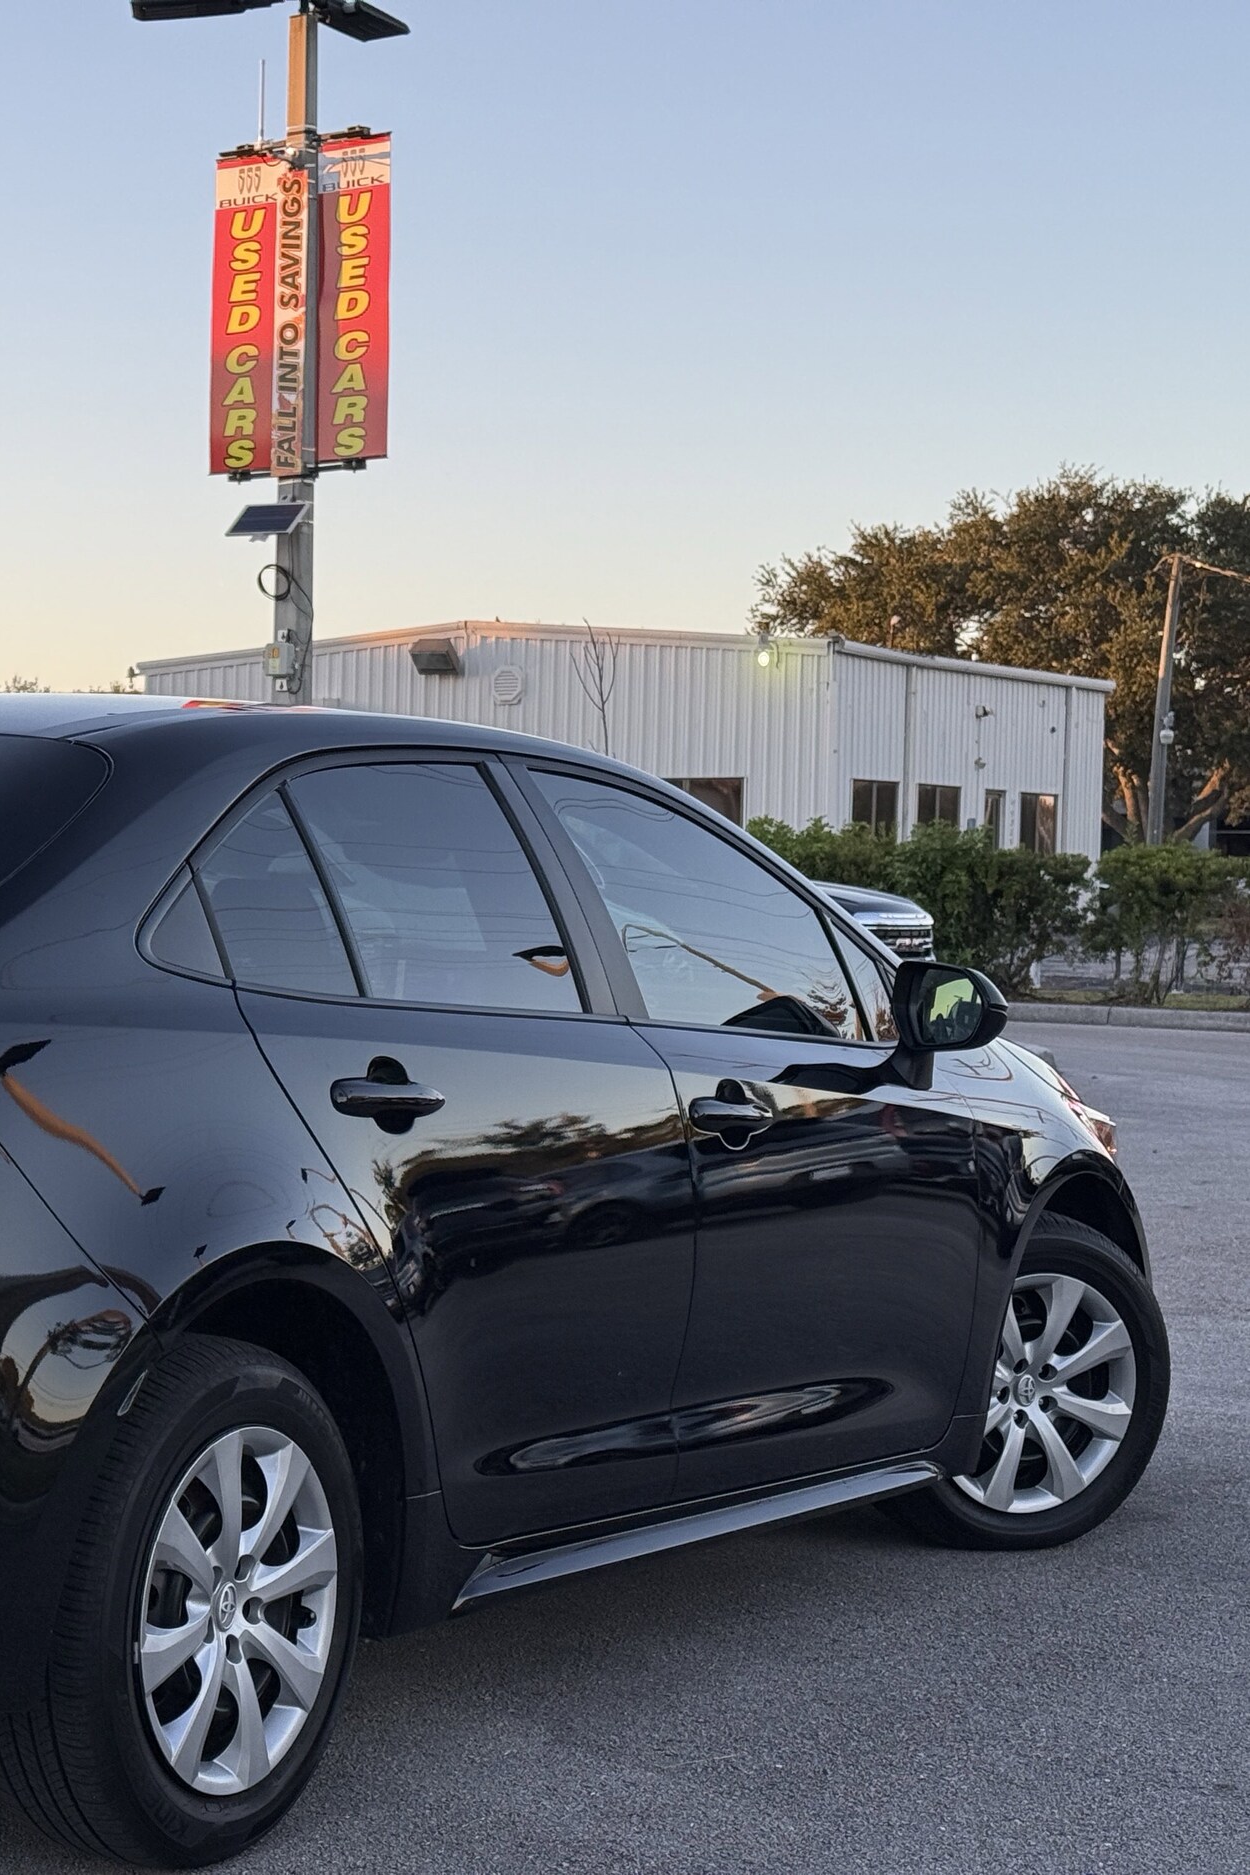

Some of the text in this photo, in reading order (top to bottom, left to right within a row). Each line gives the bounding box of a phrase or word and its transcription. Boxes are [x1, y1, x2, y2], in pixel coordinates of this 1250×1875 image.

[219, 192, 278, 209] BUICK
[322, 174, 385, 193] BUICK
[221, 206, 267, 469] USED CARS
[276, 176, 304, 469] FALL INTO SAVINGS
[330, 189, 372, 457] USED CARS
